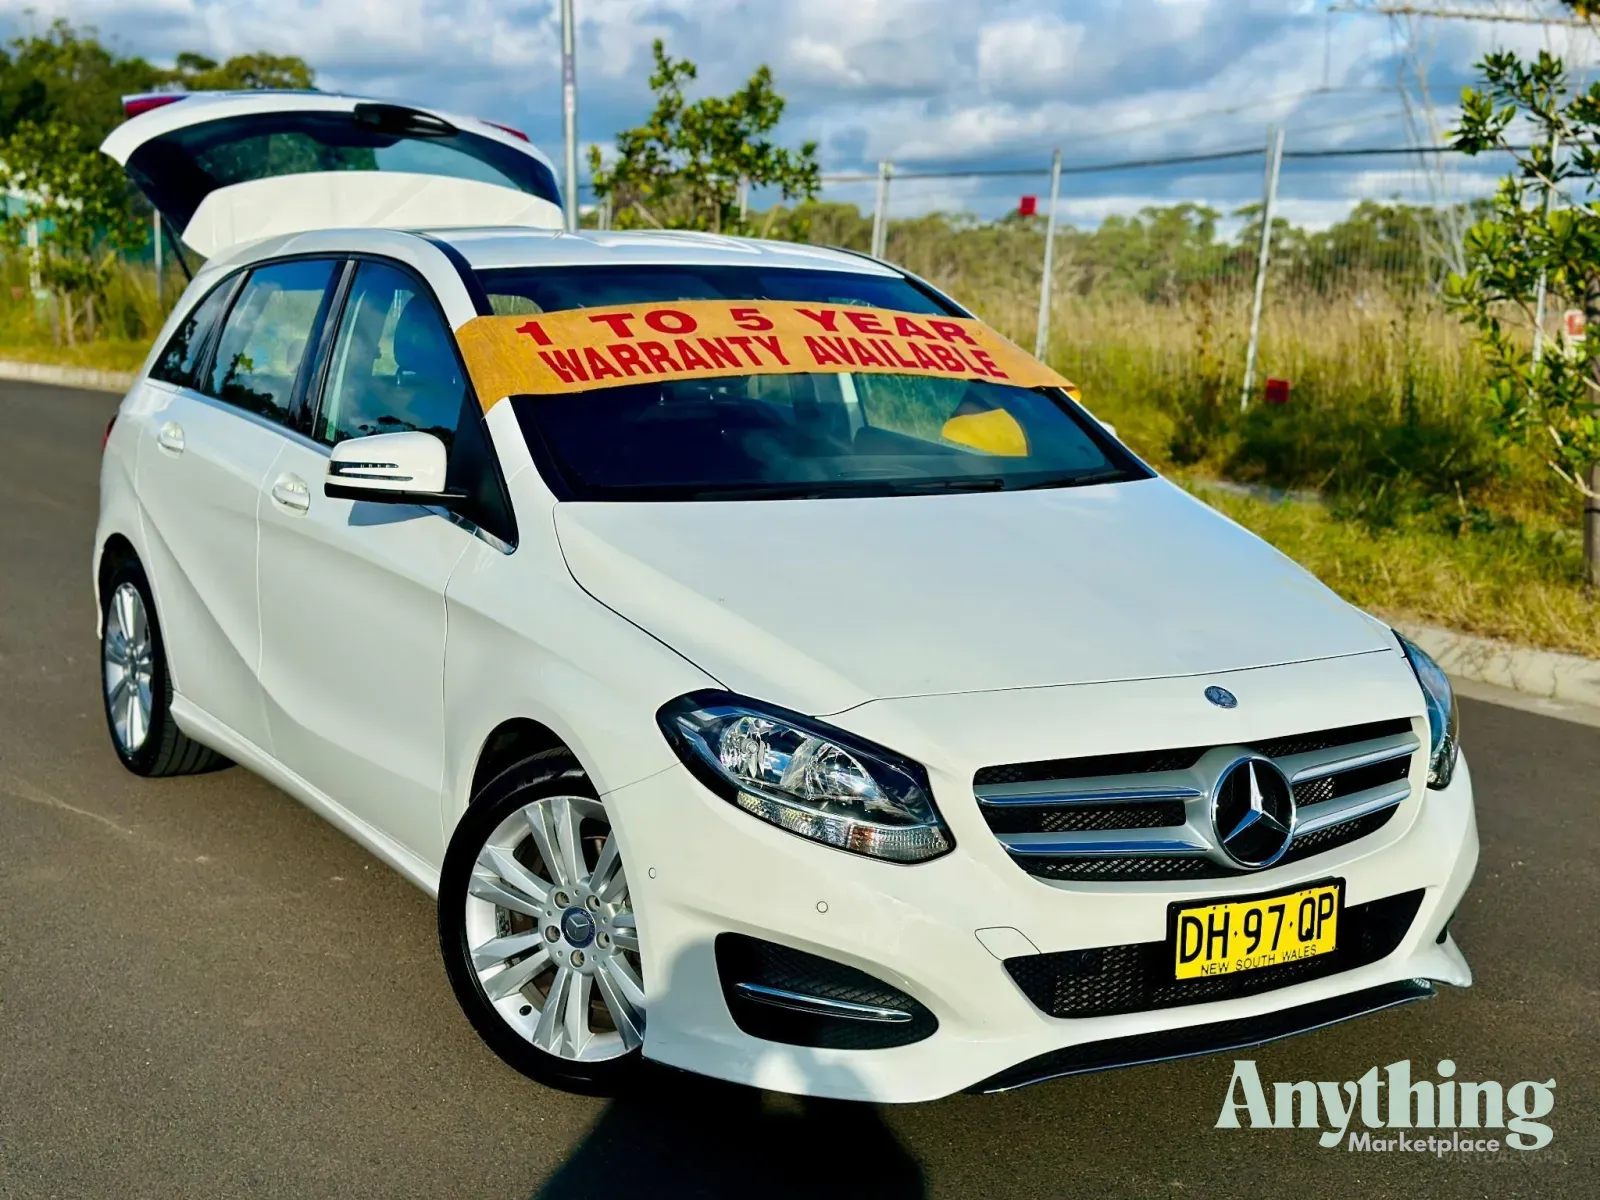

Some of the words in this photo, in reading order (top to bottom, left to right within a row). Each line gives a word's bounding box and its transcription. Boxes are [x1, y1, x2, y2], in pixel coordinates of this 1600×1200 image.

[515, 321, 553, 346] 1
[588, 309, 698, 338] TO
[729, 308, 774, 331] 5
[796, 308, 978, 346] YEAR
[537, 335, 791, 384] WARRANTY
[803, 335, 1010, 379] AVAILABLE
[1200, 962, 1230, 976] NEW
[1235, 954, 1276, 971] SOUTH
[1282, 944, 1317, 962] WALES
